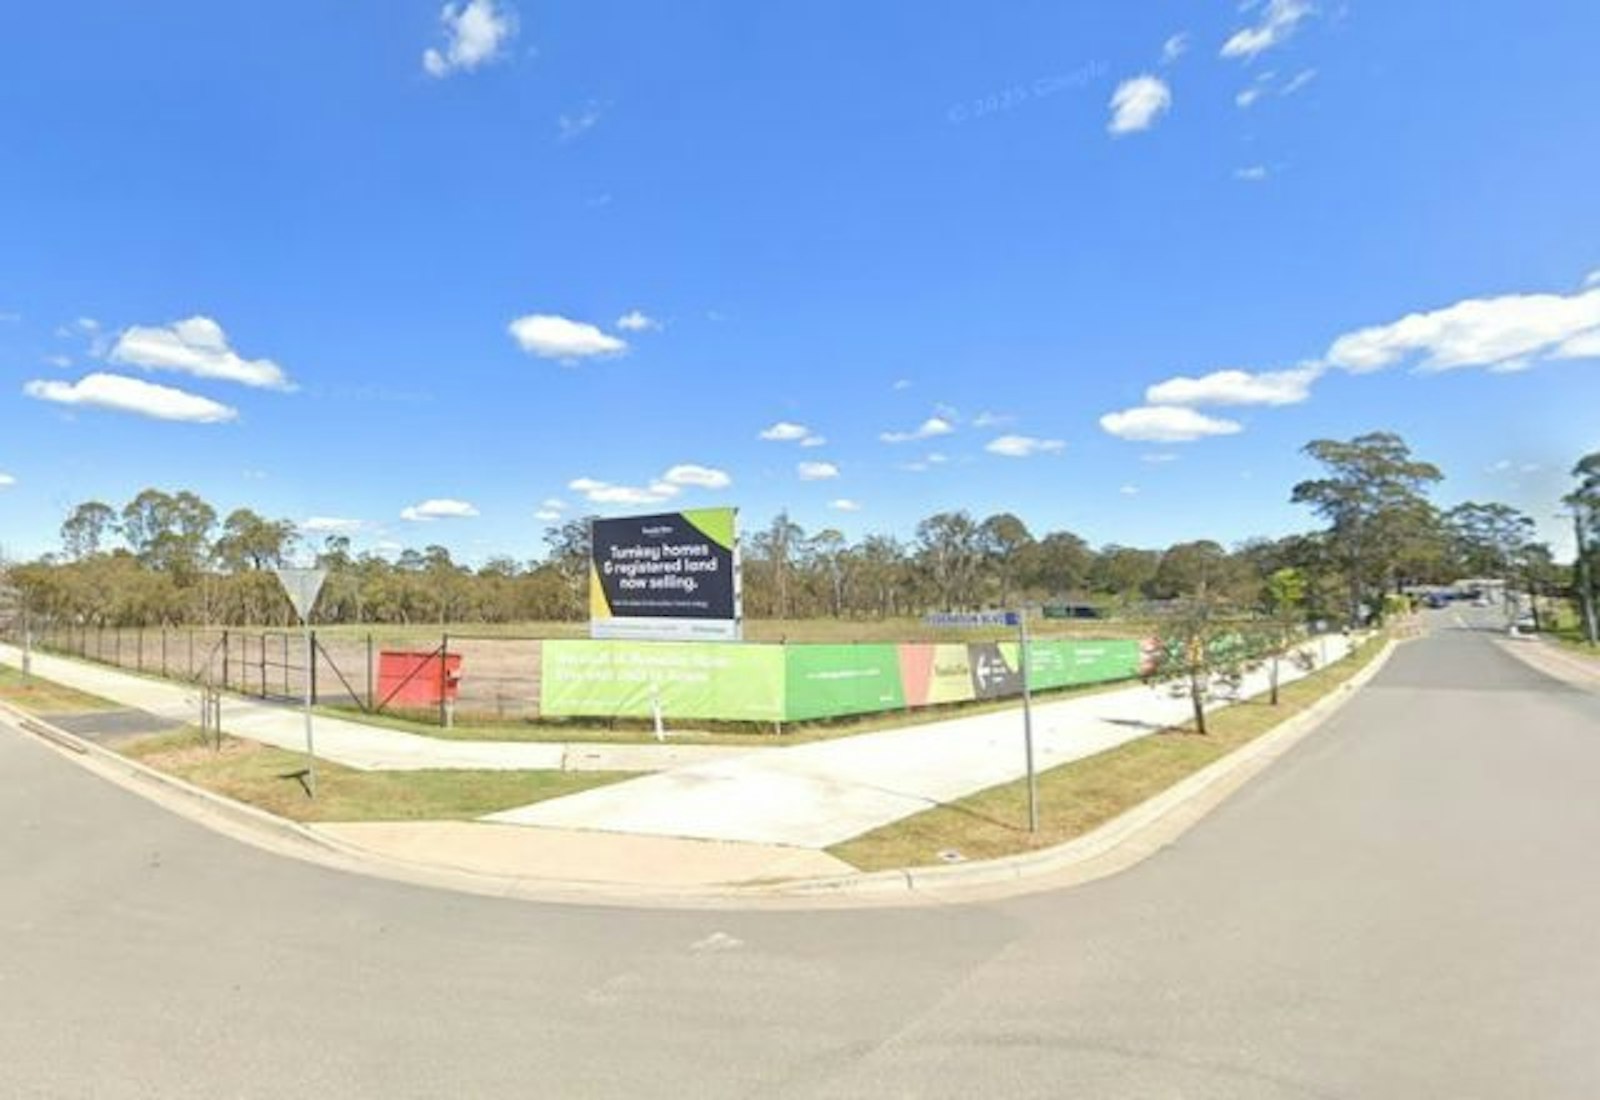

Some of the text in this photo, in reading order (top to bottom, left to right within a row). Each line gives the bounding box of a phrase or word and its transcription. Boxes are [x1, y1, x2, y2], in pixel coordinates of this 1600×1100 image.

[610, 543, 709, 561] Turnkey homes
[615, 558, 682, 577] registered
[684, 557, 718, 572] land
[619, 574, 698, 594] now selling.
